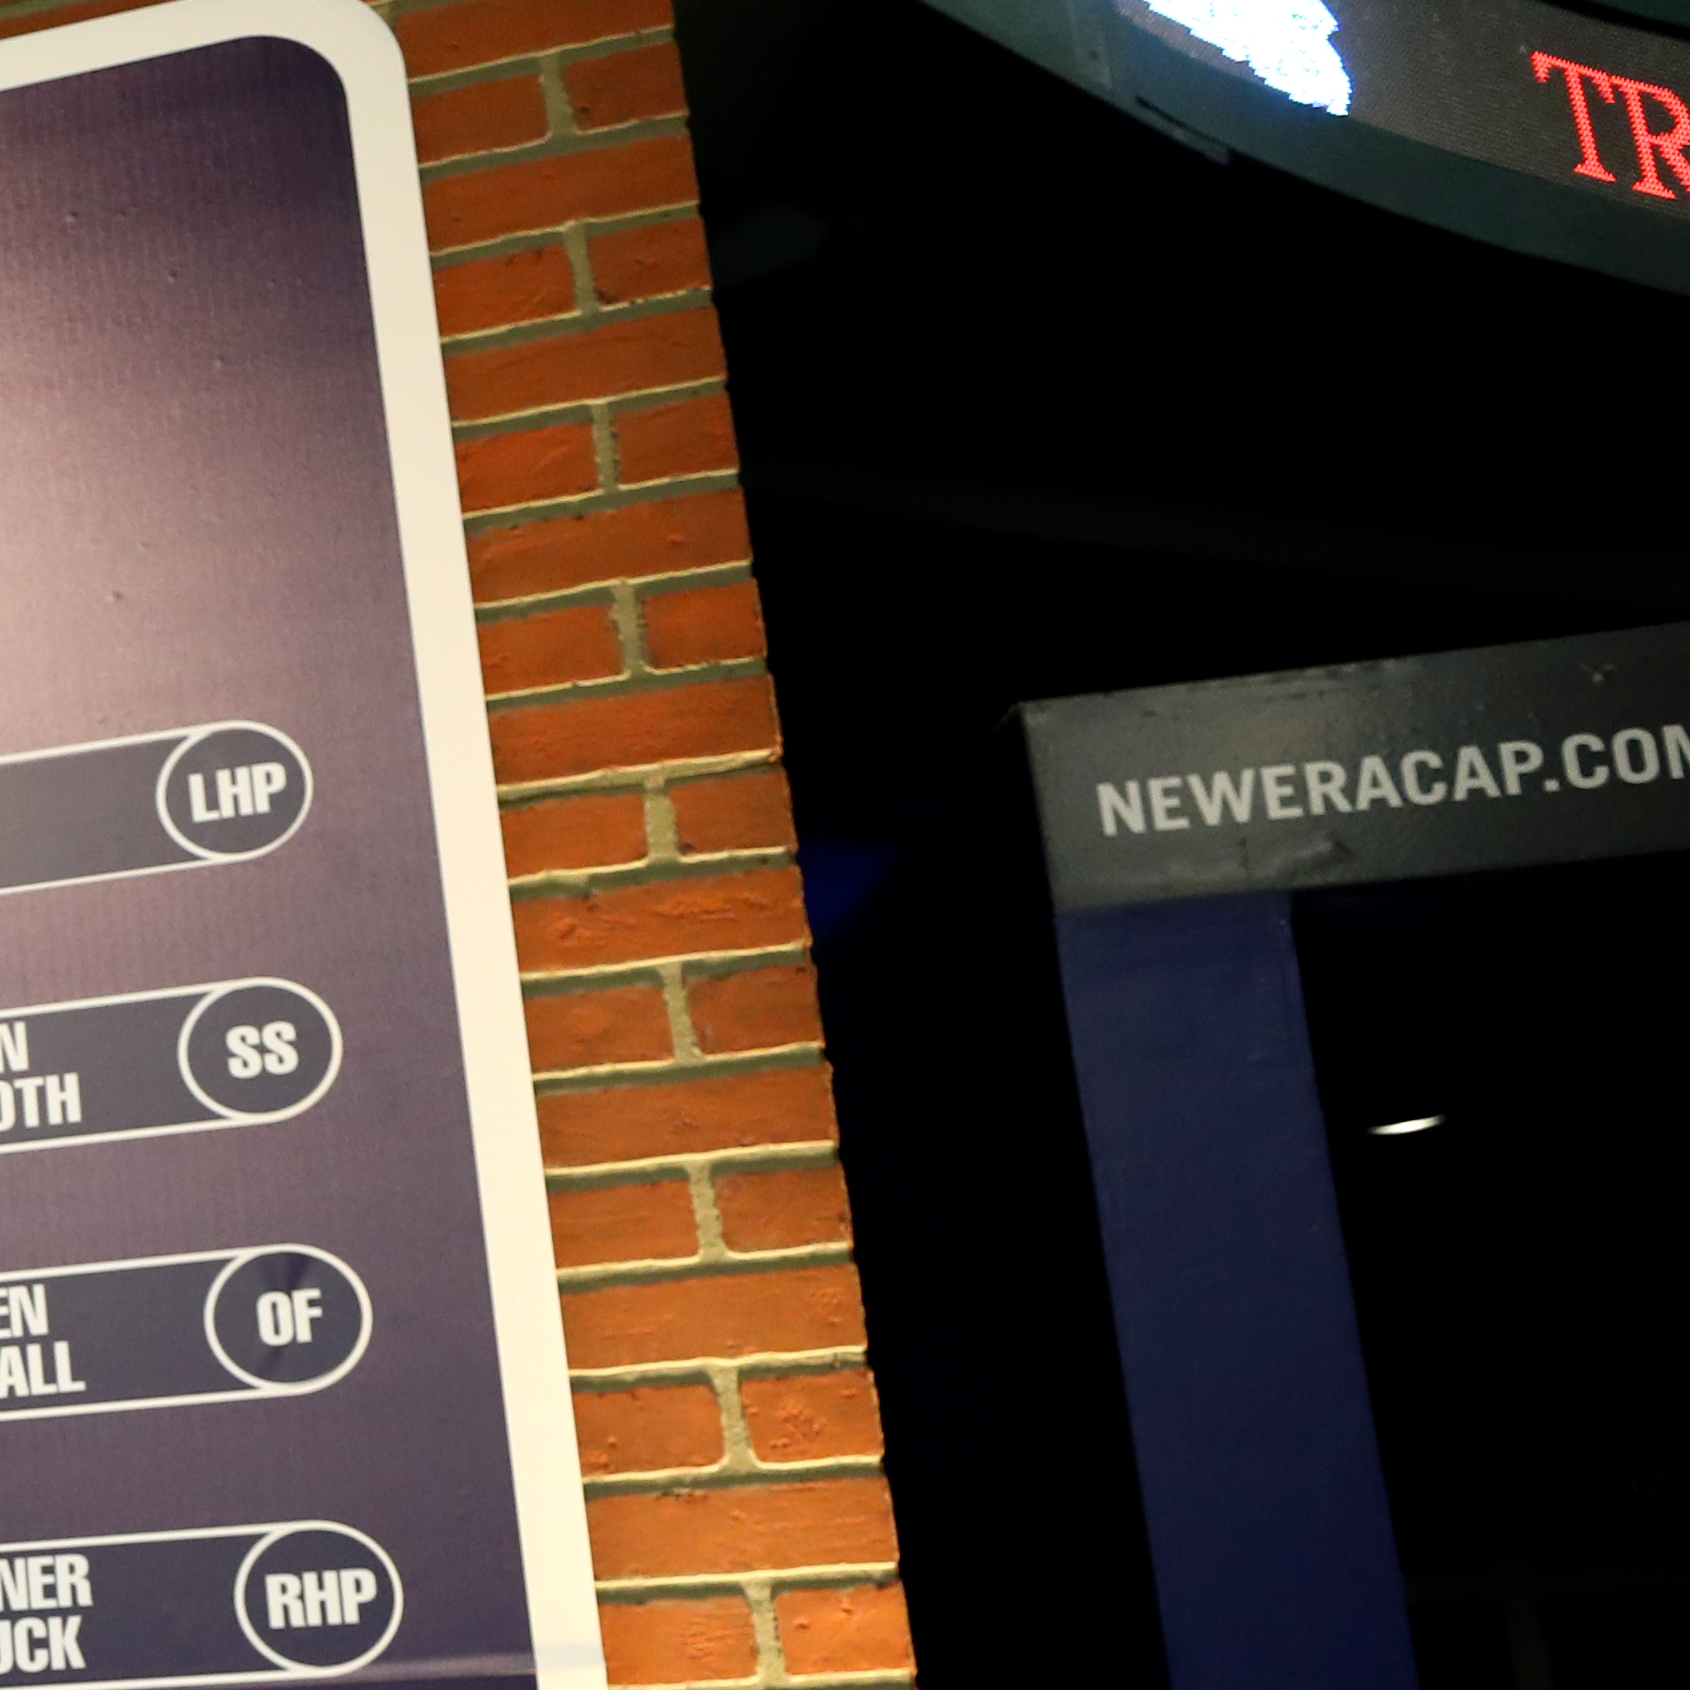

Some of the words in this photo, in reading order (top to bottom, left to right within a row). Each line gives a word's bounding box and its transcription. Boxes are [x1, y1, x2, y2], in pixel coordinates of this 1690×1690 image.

[188, 762, 286, 823] LHP
[226, 1021, 298, 1079] SS
[256, 1288, 323, 1346] OF
[265, 1568, 377, 1629] RHP
